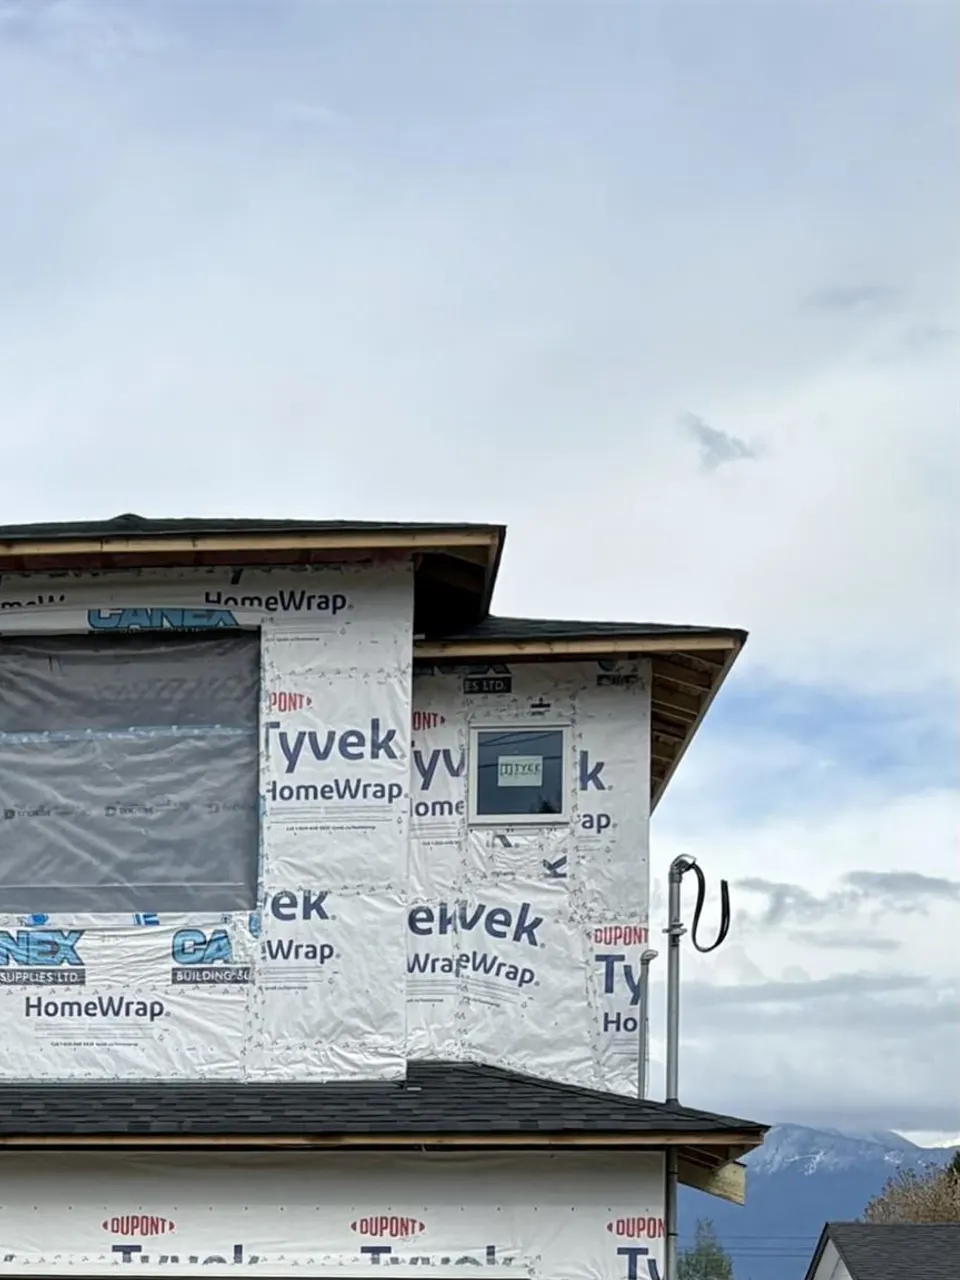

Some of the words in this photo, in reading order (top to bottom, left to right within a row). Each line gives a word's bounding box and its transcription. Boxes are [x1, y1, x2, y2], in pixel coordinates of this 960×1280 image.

[412, 742, 464, 790] yv
[578, 812, 611, 833] ap
[0, 972, 53, 982] SUPPLIES
[176, 970, 232, 981] BUILDING
[25, 996, 165, 1021] HomeWrap
[111, 1215, 167, 1236] DUPONT
[359, 1216, 418, 1237] DUPONT
